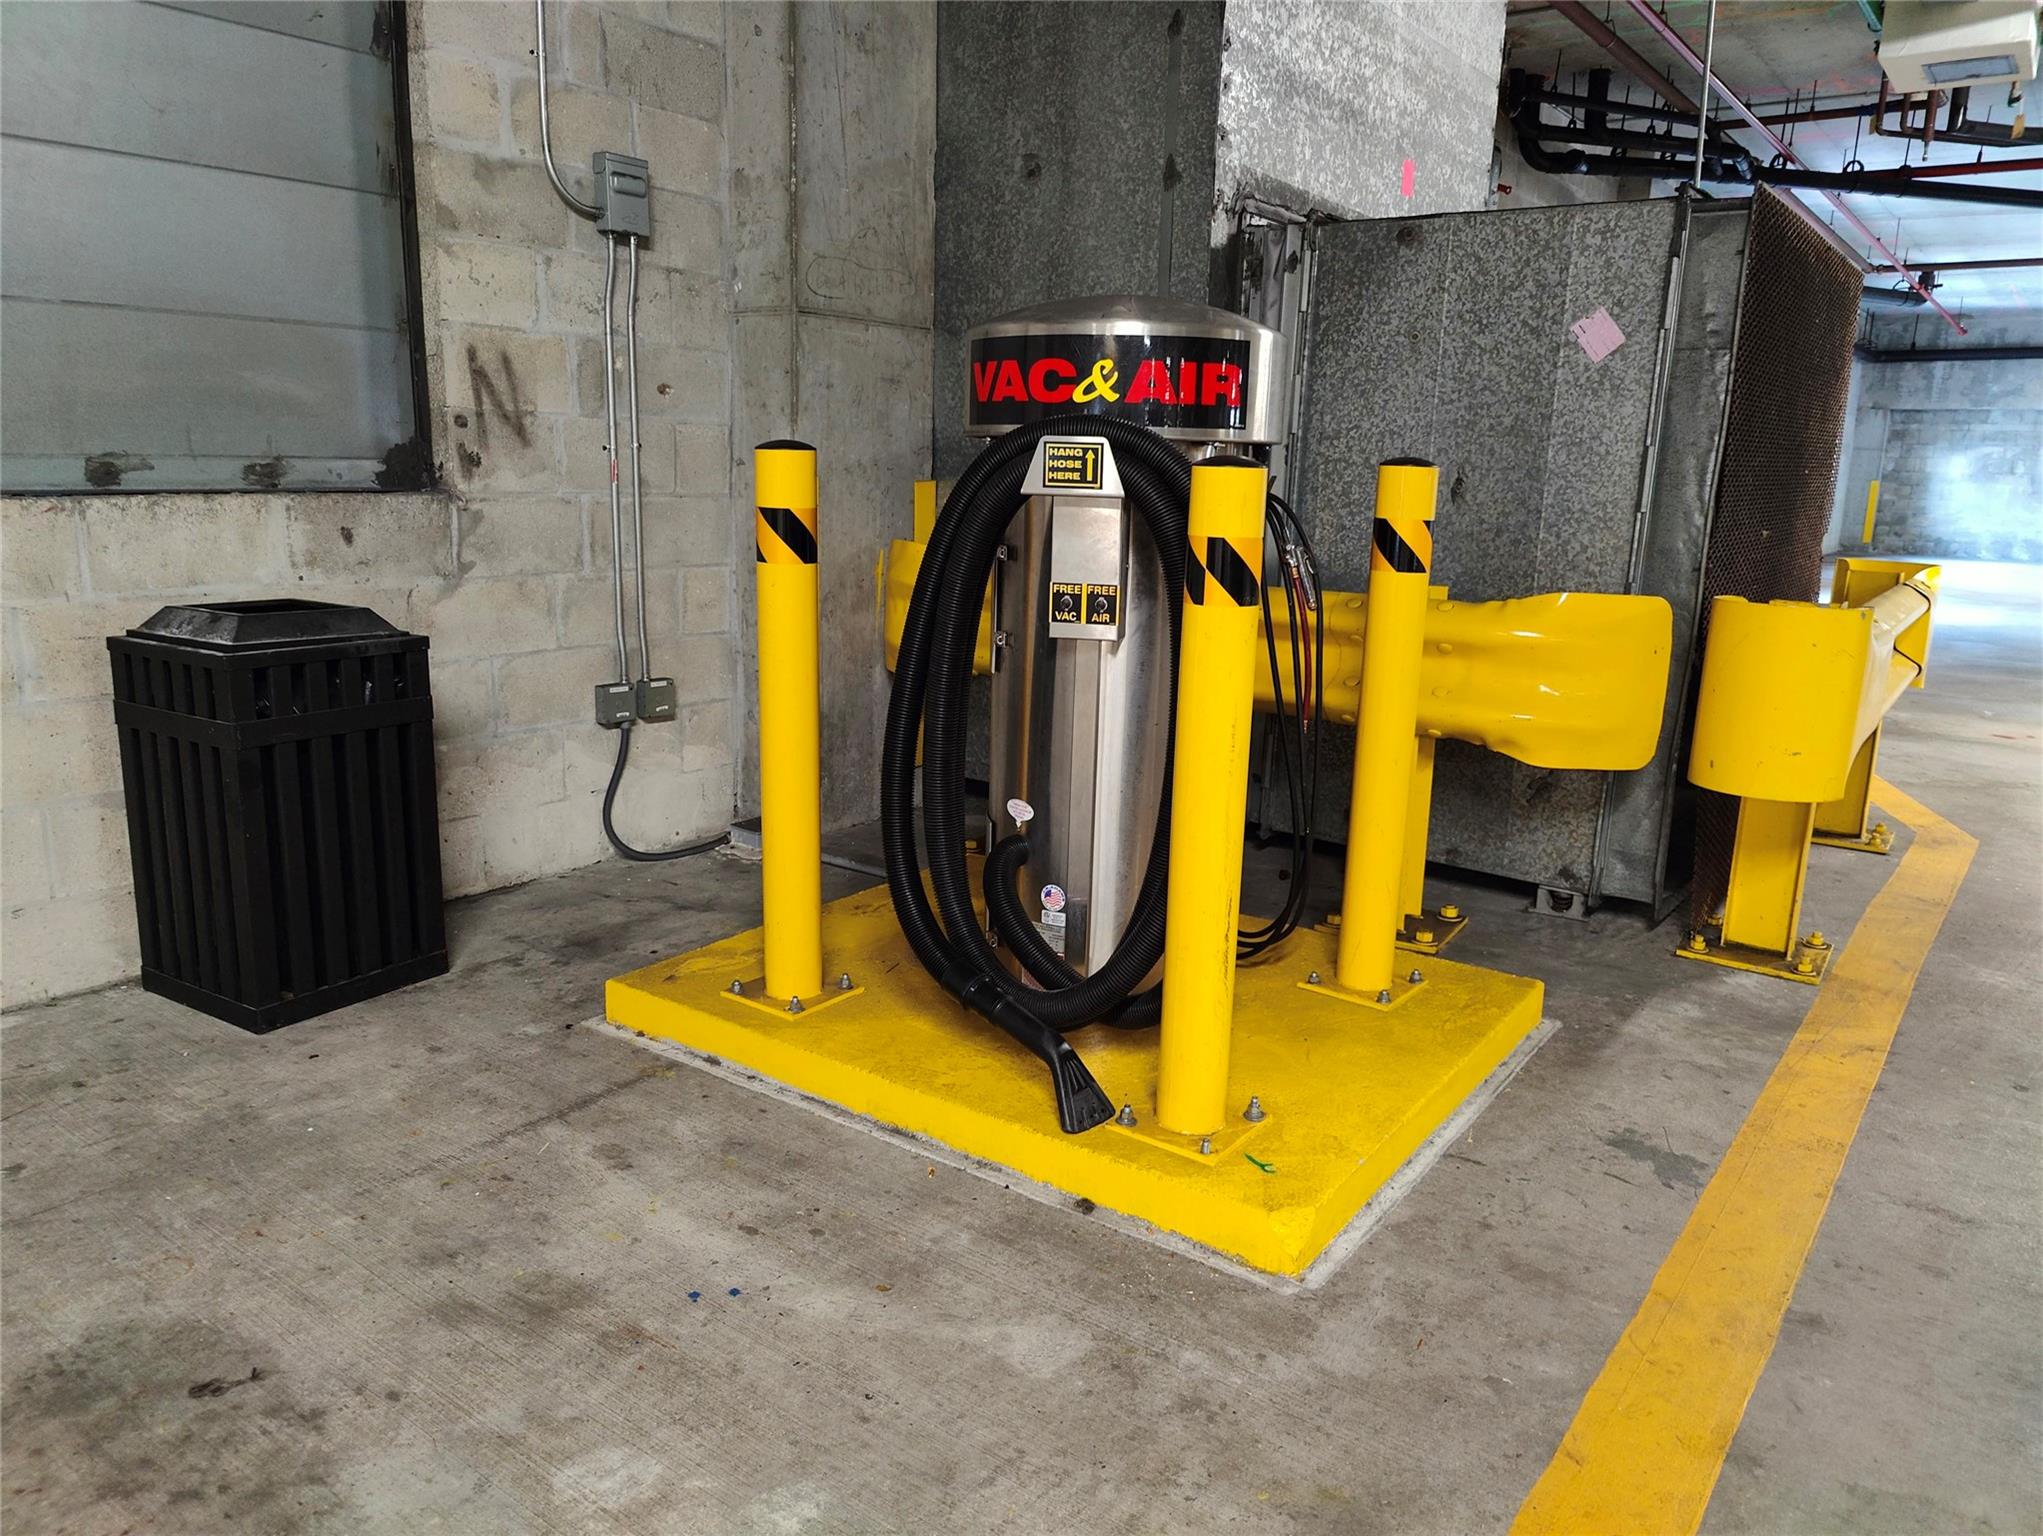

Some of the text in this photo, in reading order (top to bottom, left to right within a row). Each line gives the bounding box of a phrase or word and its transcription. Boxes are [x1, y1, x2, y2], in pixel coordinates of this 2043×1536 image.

[974, 358, 1243, 407] VAC & AIR
[1049, 447, 1083, 457] HANG
[1049, 459, 1082, 469] HOSE
[1048, 471, 1081, 480] HERE
[1053, 583, 1082, 594] FREE
[1087, 585, 1116, 596] FREE
[1055, 610, 1077, 621] VAC
[1091, 613, 1110, 623] AIR
